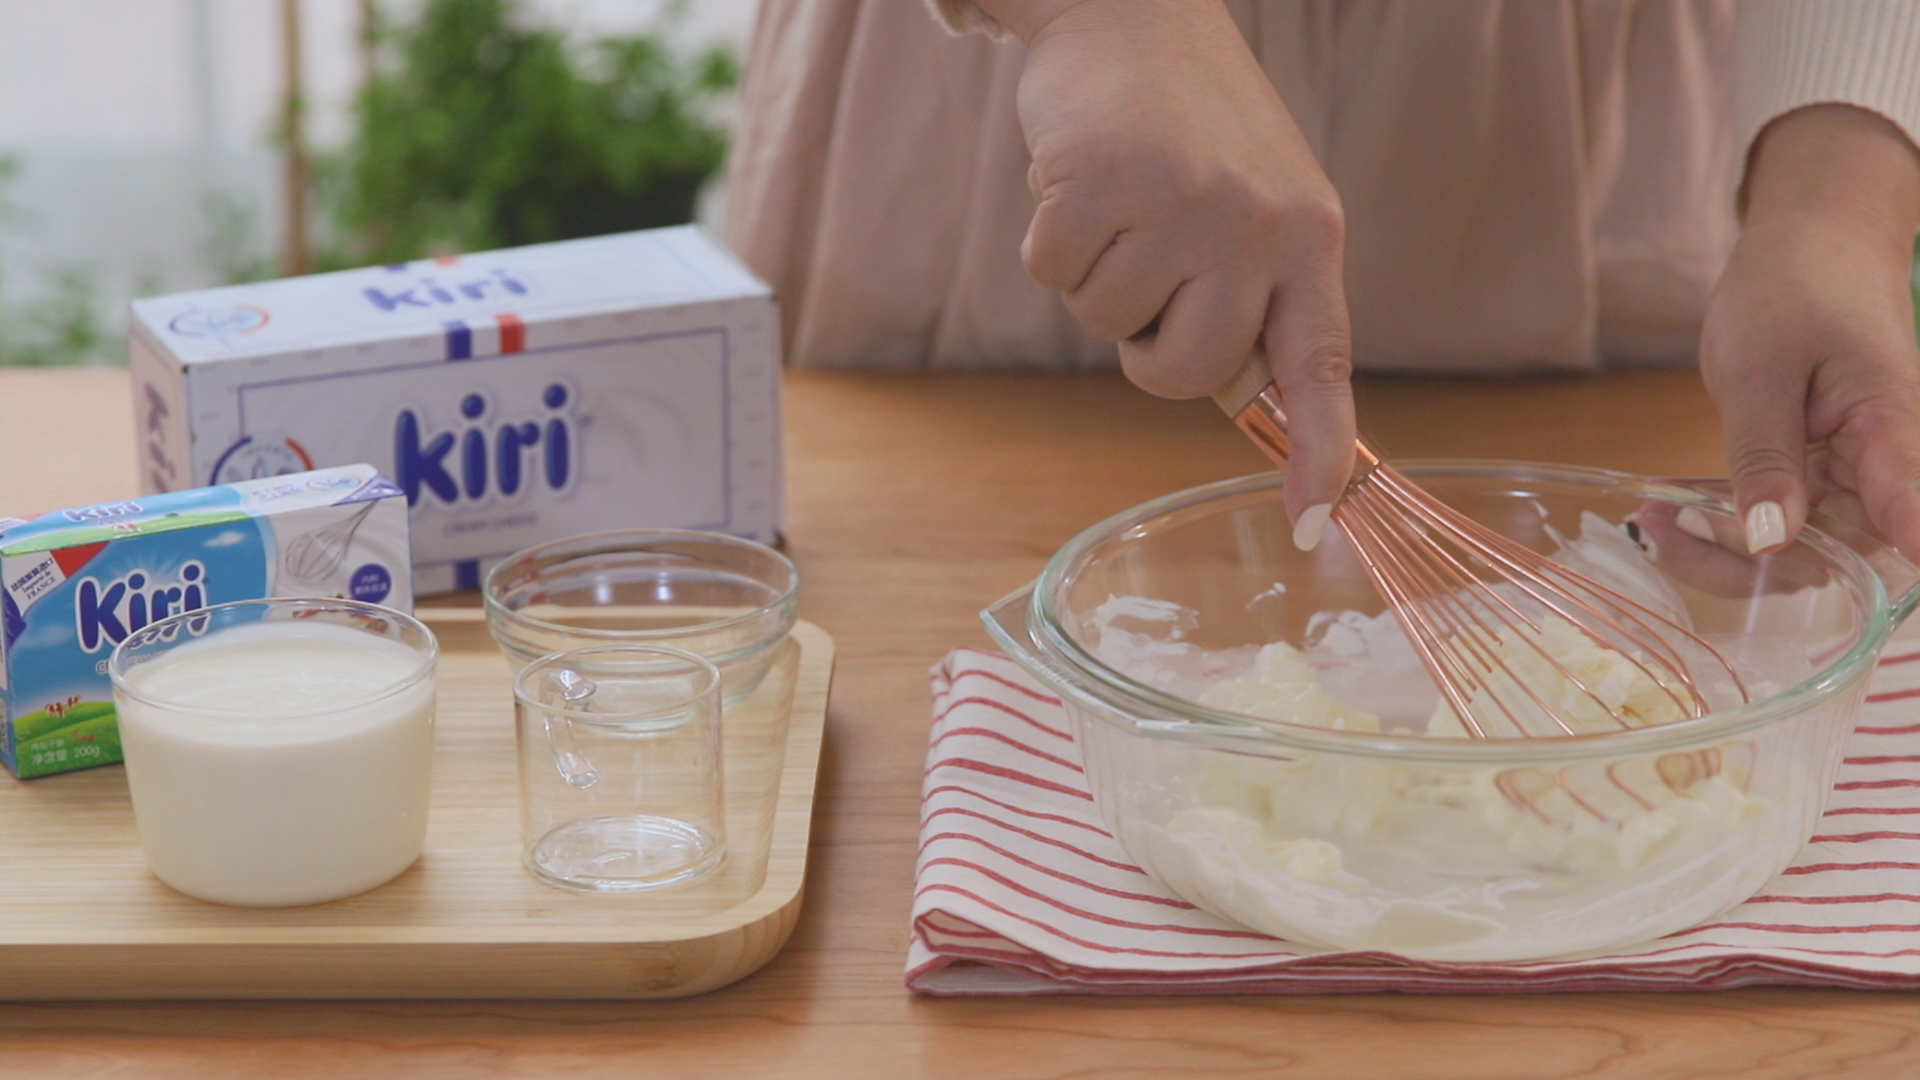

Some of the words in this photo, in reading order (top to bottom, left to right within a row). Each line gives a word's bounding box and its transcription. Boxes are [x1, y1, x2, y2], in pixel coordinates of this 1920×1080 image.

[363, 267, 528, 312] kiri
[394, 383, 569, 509] kiri
[26, 576, 56, 600] FRANCE
[77, 562, 206, 650] Kiri
[74, 745, 100, 759] 200g
